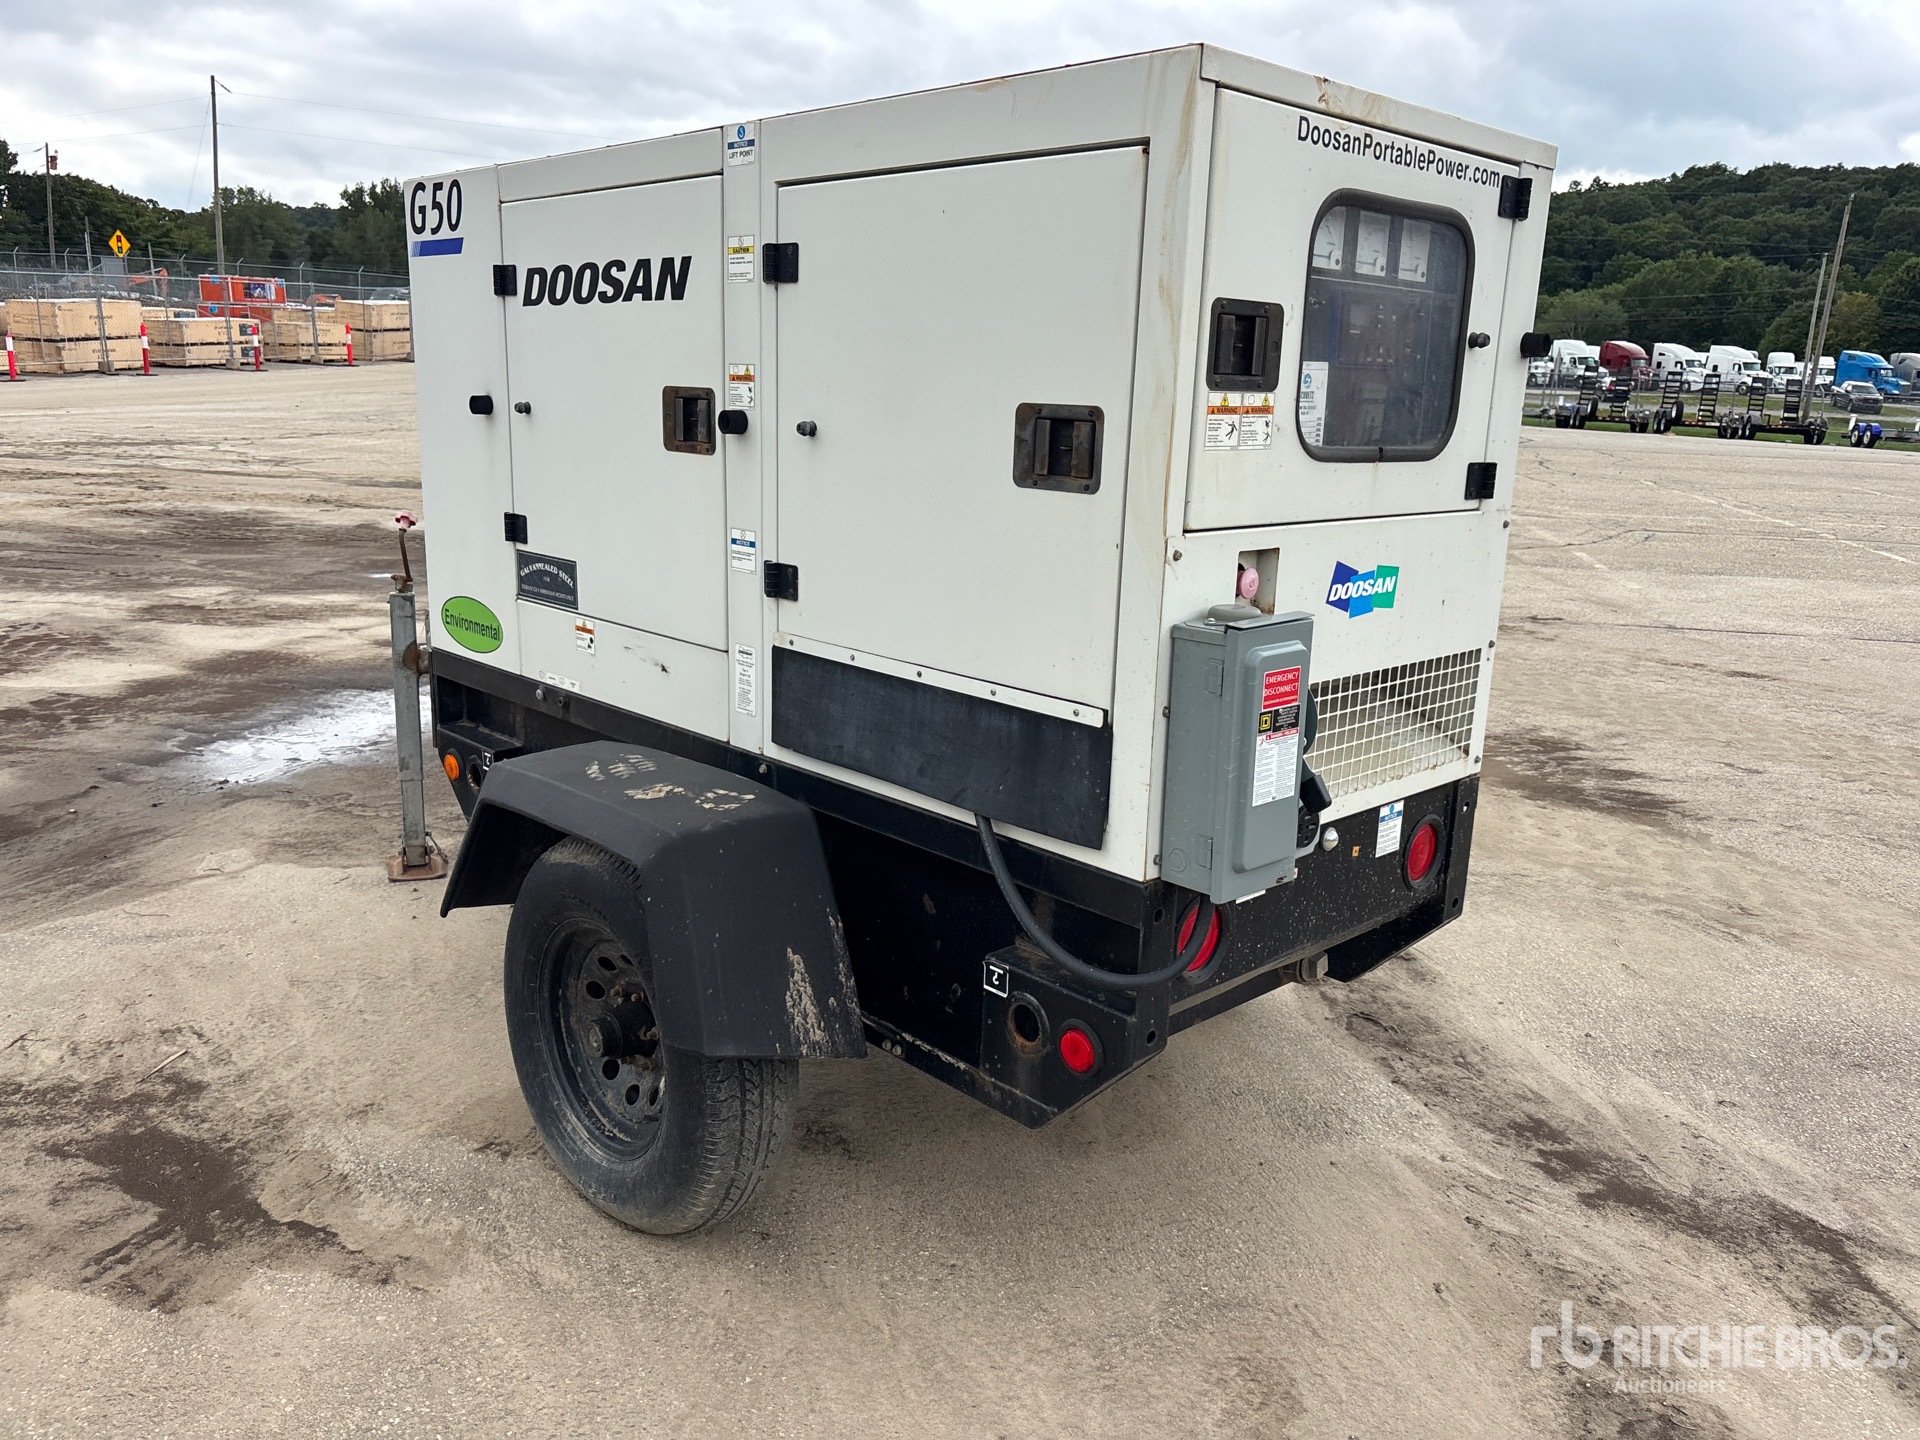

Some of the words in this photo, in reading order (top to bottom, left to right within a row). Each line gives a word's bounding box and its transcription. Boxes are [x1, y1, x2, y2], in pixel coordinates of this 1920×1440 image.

[728, 151, 738, 159] LIFT
[739, 149, 754, 158] POINT
[1297, 115, 1501, 188] DoosanPortablePower.com
[410, 179, 462, 235] G50
[522, 255, 692, 307] DOOSAN
[558, 570, 574, 589] STEEL
[1328, 576, 1397, 602] DOOSAN
[445, 608, 500, 641] Environmental
[1264, 683, 1298, 696] DISCONNECT
[1266, 672, 1298, 684] EMERGENCY
